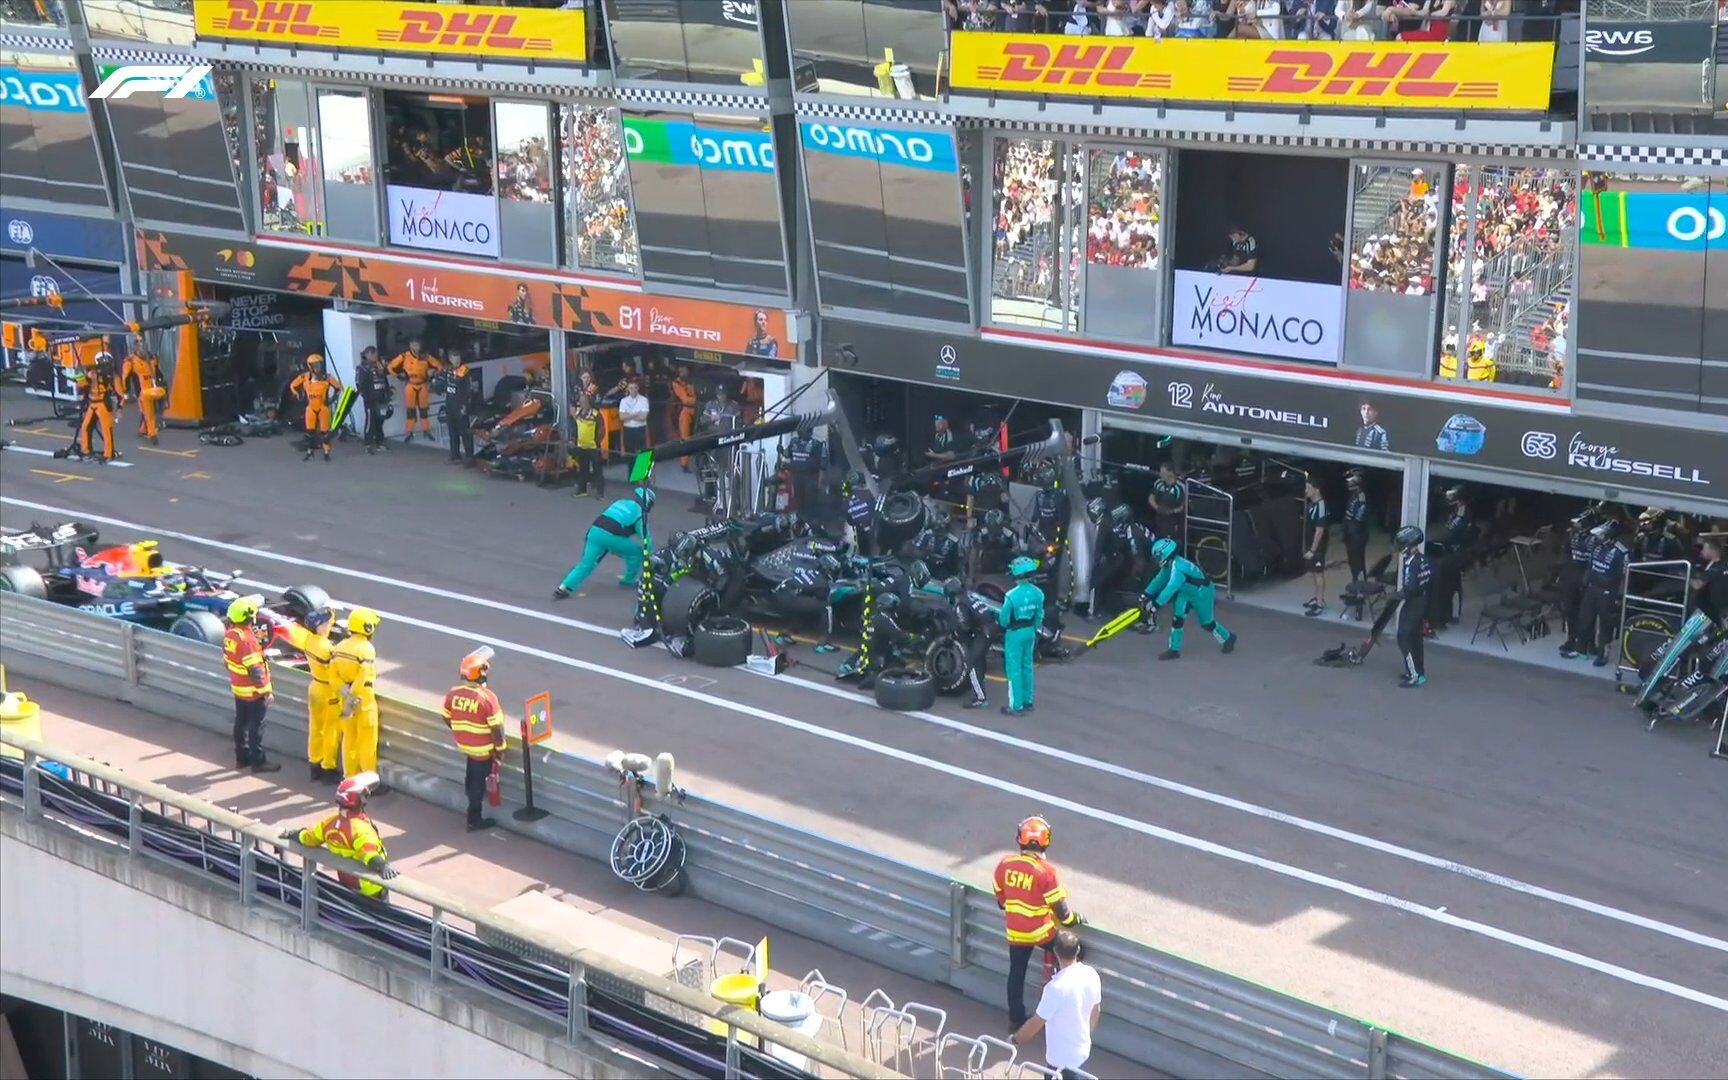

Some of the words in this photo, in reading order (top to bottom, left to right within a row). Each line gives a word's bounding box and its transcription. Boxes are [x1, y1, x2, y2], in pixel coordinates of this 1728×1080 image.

[226, 0, 320, 36] DHL
[399, 10, 527, 48] DHL
[1000, 43, 1142, 87] DHL
[1260, 50, 1459, 97] DHL
[402, 216, 490, 244] MONACO
[230, 294, 278, 308] NEVER
[406, 278, 415, 301] 1
[421, 291, 485, 311] NORRIS
[1194, 277, 1264, 316] Visit
[231, 304, 269, 318] STOP
[619, 305, 642, 332] 81
[649, 323, 721, 342] PIASTRI
[1191, 307, 1323, 345] MONACO
[1168, 381, 1193, 409] 12
[1202, 401, 1329, 429] ANTONELLI
[1521, 431, 1557, 459] 63
[1567, 431, 1619, 467] George
[1567, 453, 1711, 485] RUSSELL
[451, 695, 479, 714] CSPM
[1004, 868, 1034, 892] CSPM
